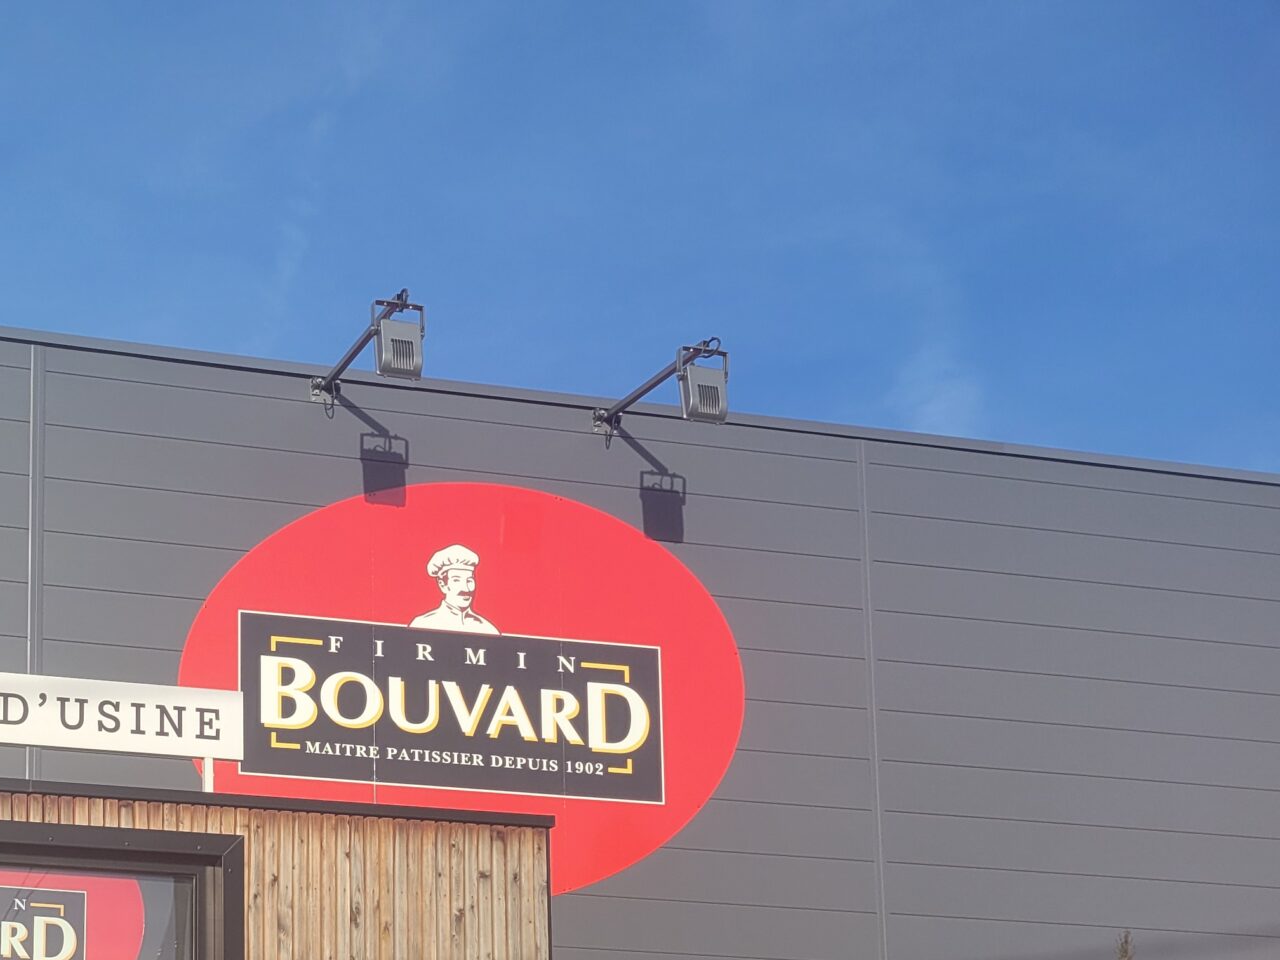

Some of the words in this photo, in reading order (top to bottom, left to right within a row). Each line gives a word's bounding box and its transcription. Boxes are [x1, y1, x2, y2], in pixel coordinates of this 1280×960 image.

[328, 635, 576, 674] FIRMIN
[260, 655, 650, 754] BOUVARD
[305, 740, 380, 759] MAITRE
[386, 747, 485, 767] PATISSIER
[490, 754, 559, 772] DEPUIS
[565, 761, 604, 776] 1902
